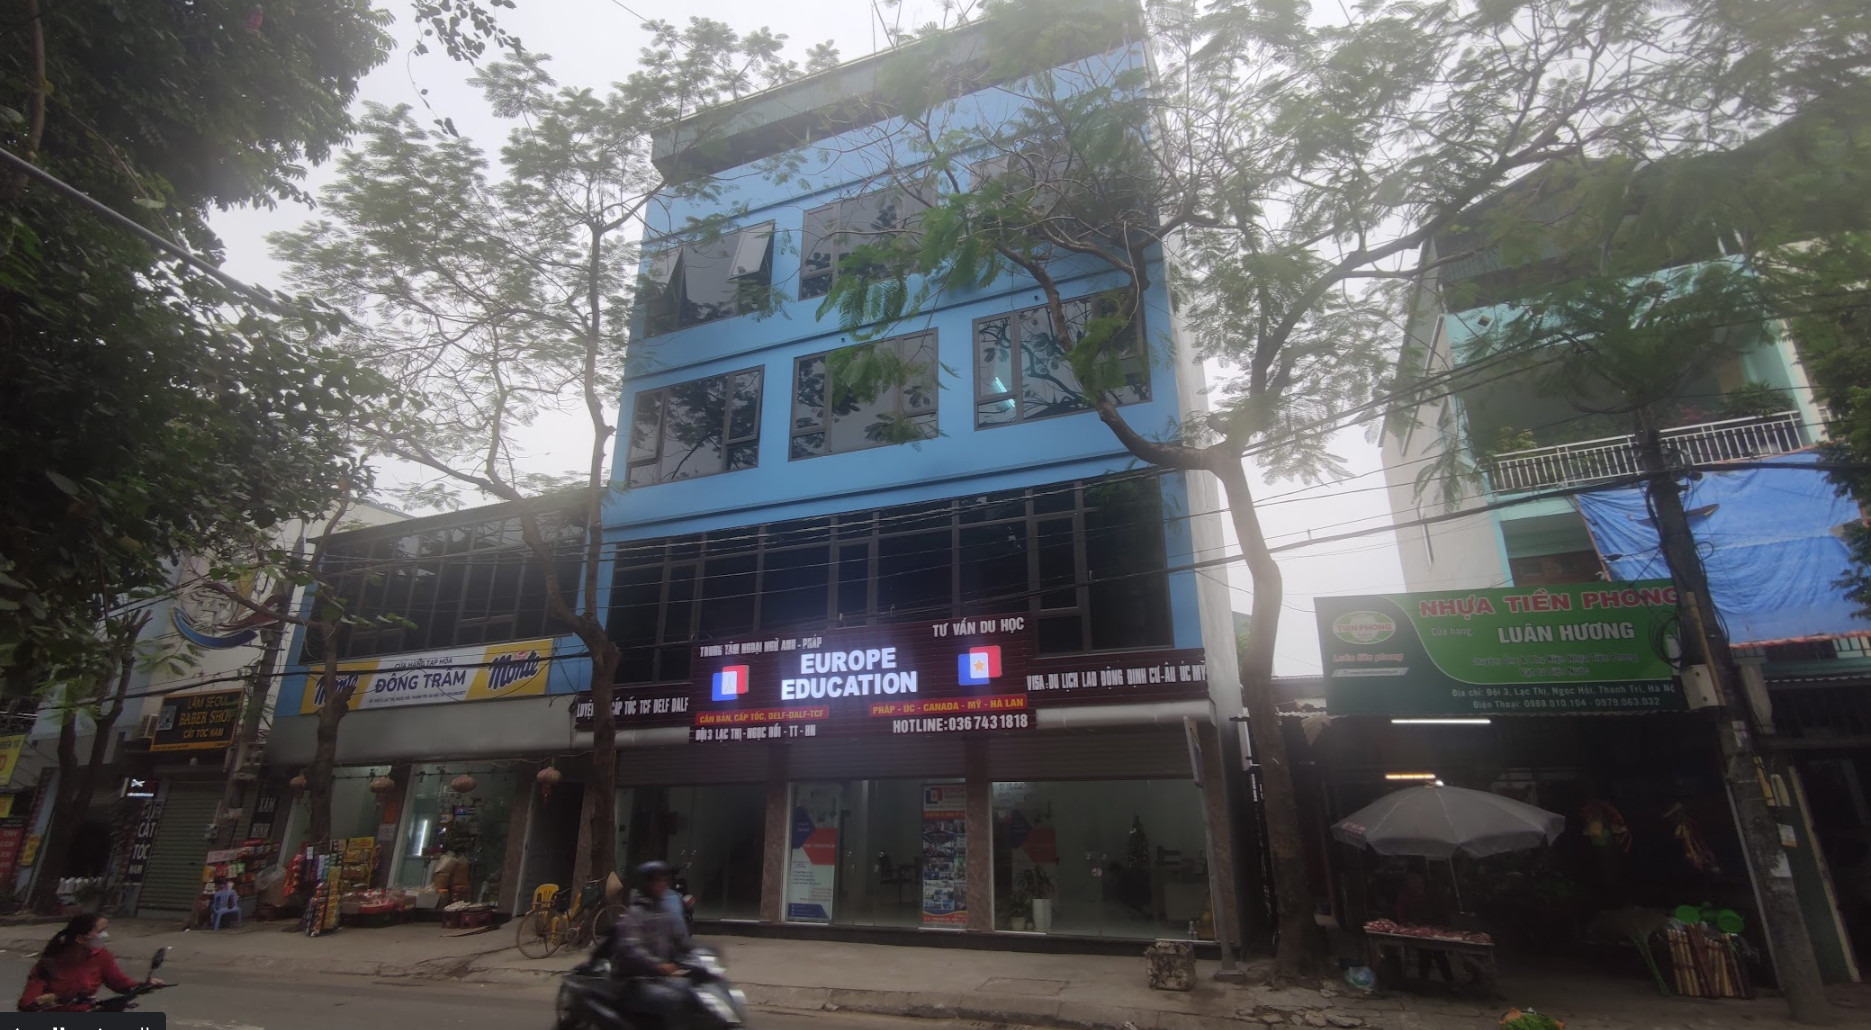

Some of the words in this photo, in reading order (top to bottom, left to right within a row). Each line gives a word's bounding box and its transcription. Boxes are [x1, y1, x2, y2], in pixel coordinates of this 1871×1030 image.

[1420, 595, 1495, 620] NHỰA
[1504, 588, 1572, 613] TIỀN
[933, 623, 948, 637] TƯ
[953, 618, 975, 635] VẤN
[980, 620, 996, 633] DU
[1001, 617, 1024, 633] HỌC
[1498, 622, 1554, 644] LUÂN
[1560, 622, 1635, 641] HƯƠNG
[488, 650, 540, 689] Monte
[800, 647, 896, 674] EUROPE
[781, 671, 917, 700] EDUCATION
[1061, 672, 1078, 692] LỊCH
[1082, 671, 1098, 687] LAO
[1100, 666, 1124, 689] ĐỘNG
[1127, 668, 1147, 688] ĐỊNH
[1180, 660, 1191, 681] ÚC
[1598, 685, 1626, 694] Thanh
[640, 698, 651, 714] TCF
[653, 698, 670, 713] DELF
[671, 697, 689, 712] DALF
[768, 709, 824, 720] DELF-DALF-TCF
[873, 704, 895, 714] PHÁP
[903, 702, 915, 713] ÚC
[923, 702, 959, 712] CANADA
[990, 698, 1004, 708] HÀ
[1005, 698, 1023, 707] LAN
[179, 711, 208, 726] BABER
[789, 725, 798, 737] TT
